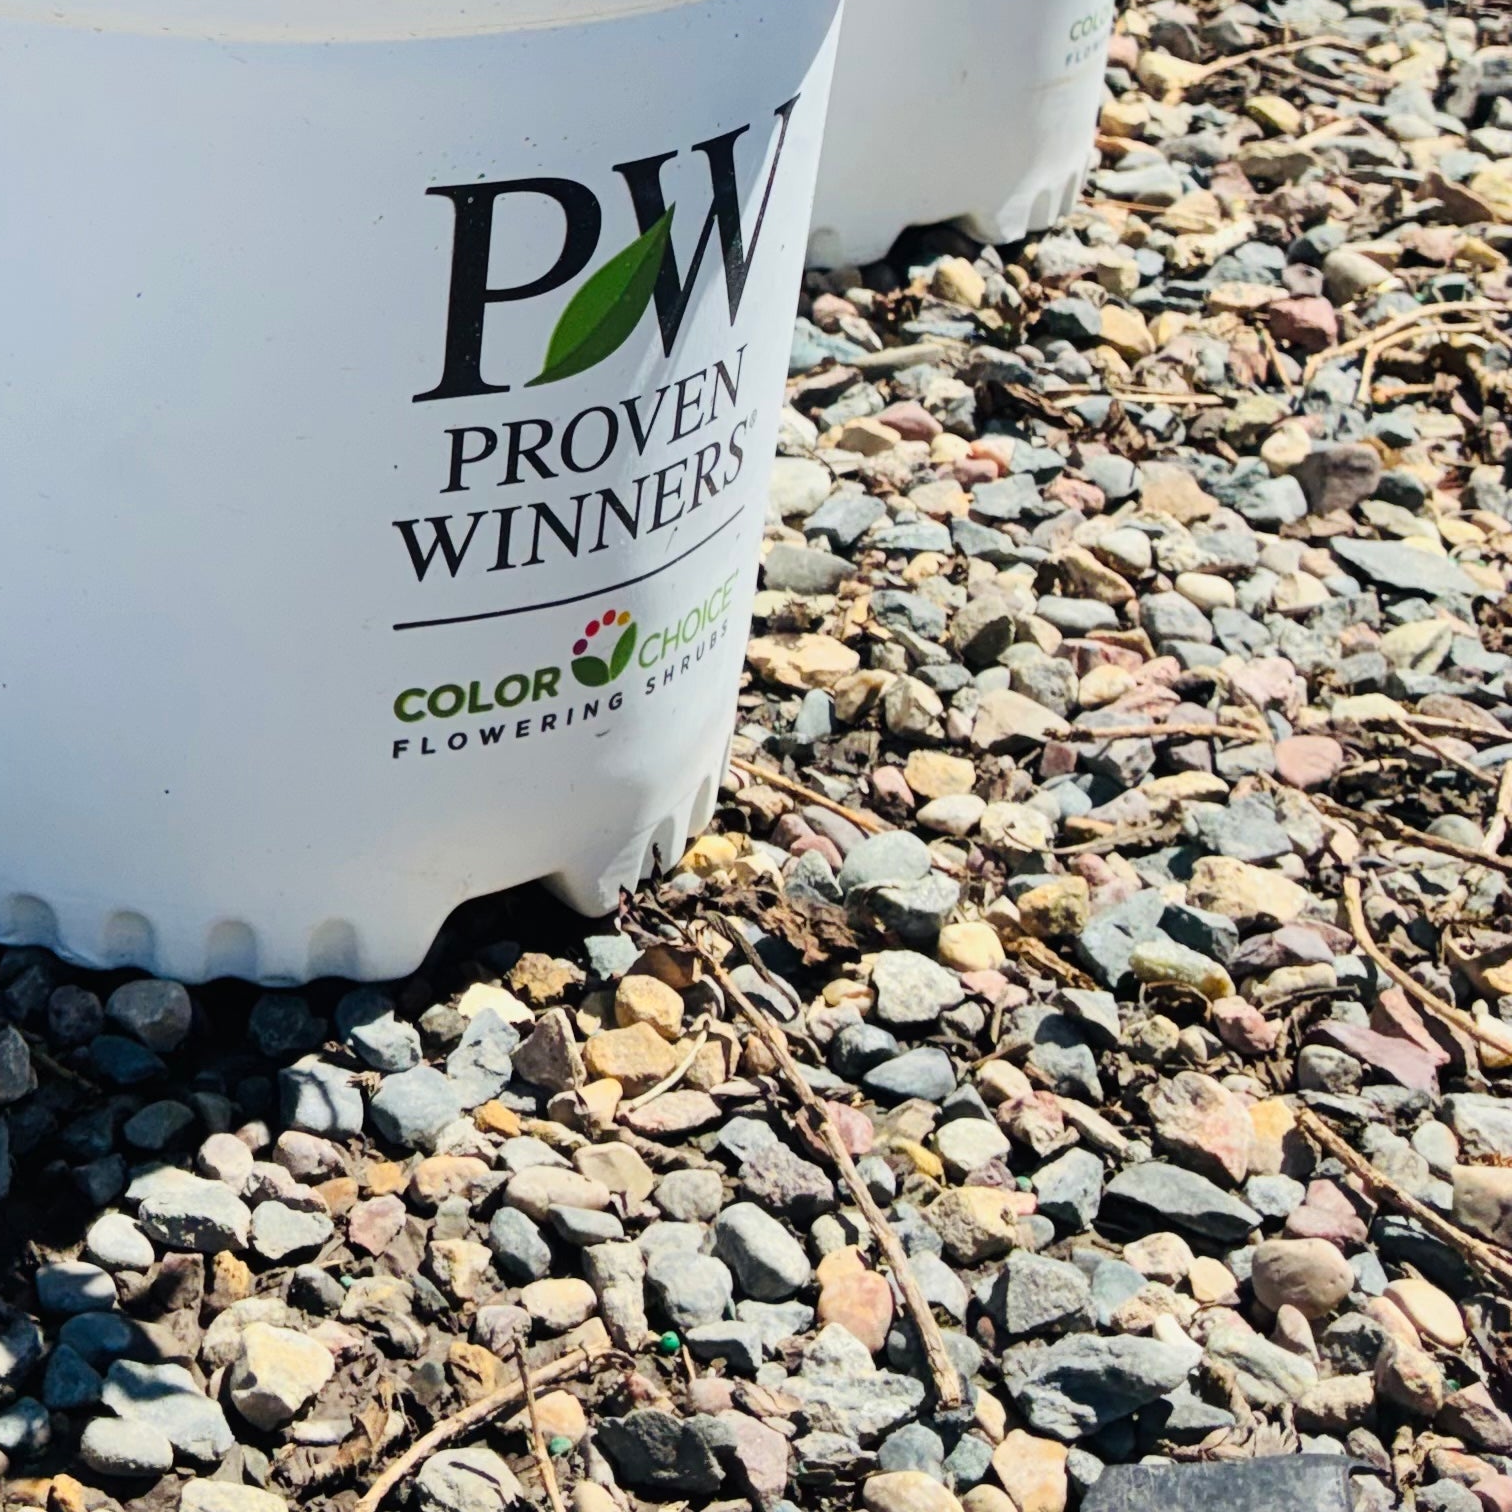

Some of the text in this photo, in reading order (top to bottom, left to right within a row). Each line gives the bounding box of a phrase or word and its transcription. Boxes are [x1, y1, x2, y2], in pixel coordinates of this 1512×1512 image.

[411, 92, 801, 403] PW
[439, 344, 748, 494] PROVEN
[392, 618, 729, 759] FLOWERING SHRUBS
[393, 666, 563, 723] COLOR
